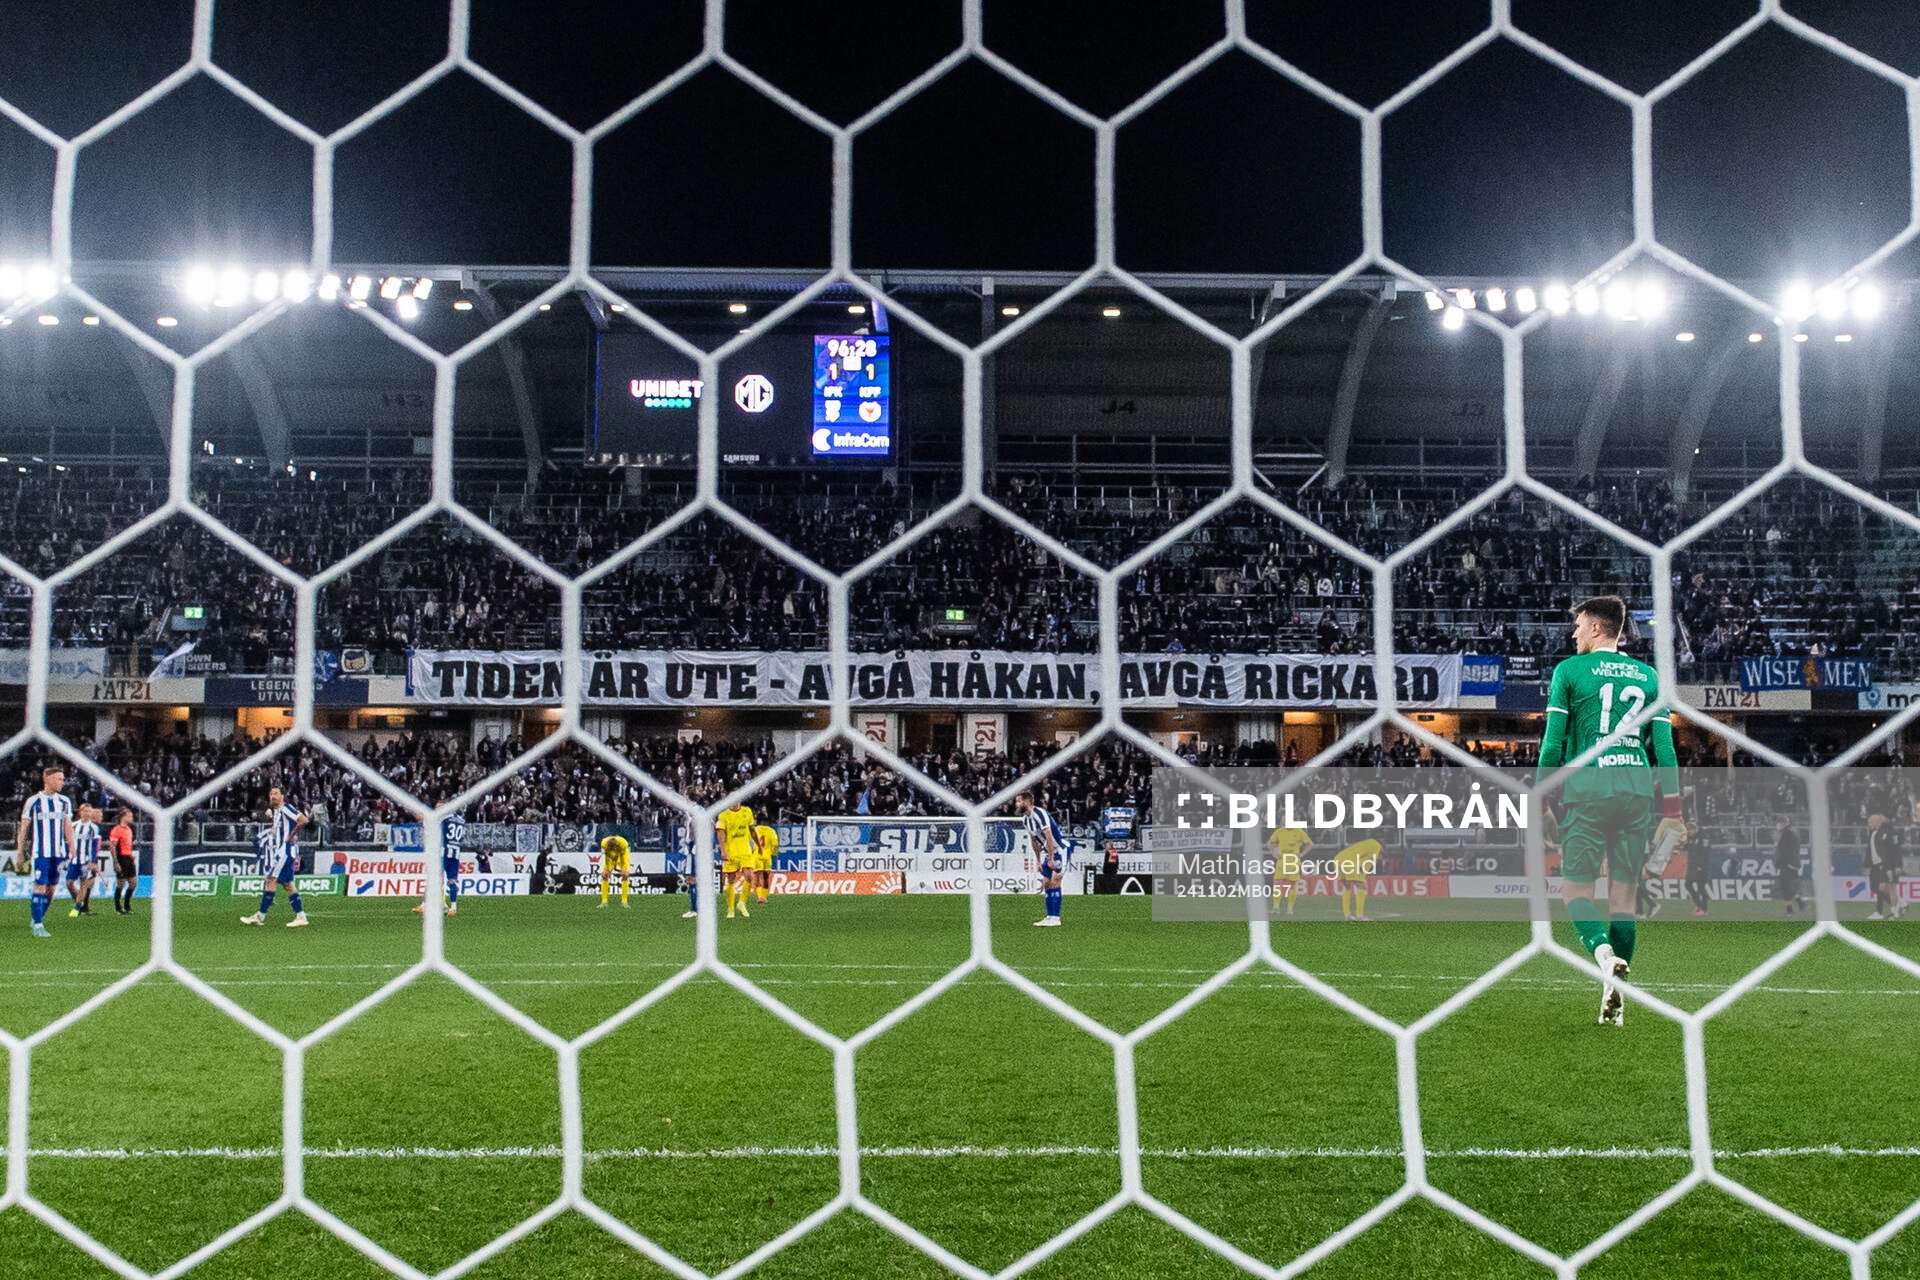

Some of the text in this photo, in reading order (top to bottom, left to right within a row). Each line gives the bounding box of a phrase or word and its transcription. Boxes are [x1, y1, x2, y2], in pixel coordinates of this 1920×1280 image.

[829, 363, 875, 380] 1 1
[631, 379, 704, 398] UNIBET
[834, 432, 890, 448] InfraCom
[1600, 661, 1639, 672] NORDIC
[1744, 658, 1871, 688] WISE MEN
[432, 661, 563, 698] TIDEN
[588, 651, 649, 699] ÄR
[665, 663, 757, 700] UTE
[929, 651, 1101, 705] HÅKAN,
[1119, 654, 1229, 700] AVGÅ
[1599, 683, 1646, 737] 12
[1598, 754, 1644, 768] MOBILL
[446, 823, 464, 841] 30
[846, 854, 913, 872] granitor
[178, 880, 210, 891] MCR
[299, 879, 330, 891] MCR
[377, 879, 520, 895] INTEPORT
[769, 873, 857, 895] Renova
